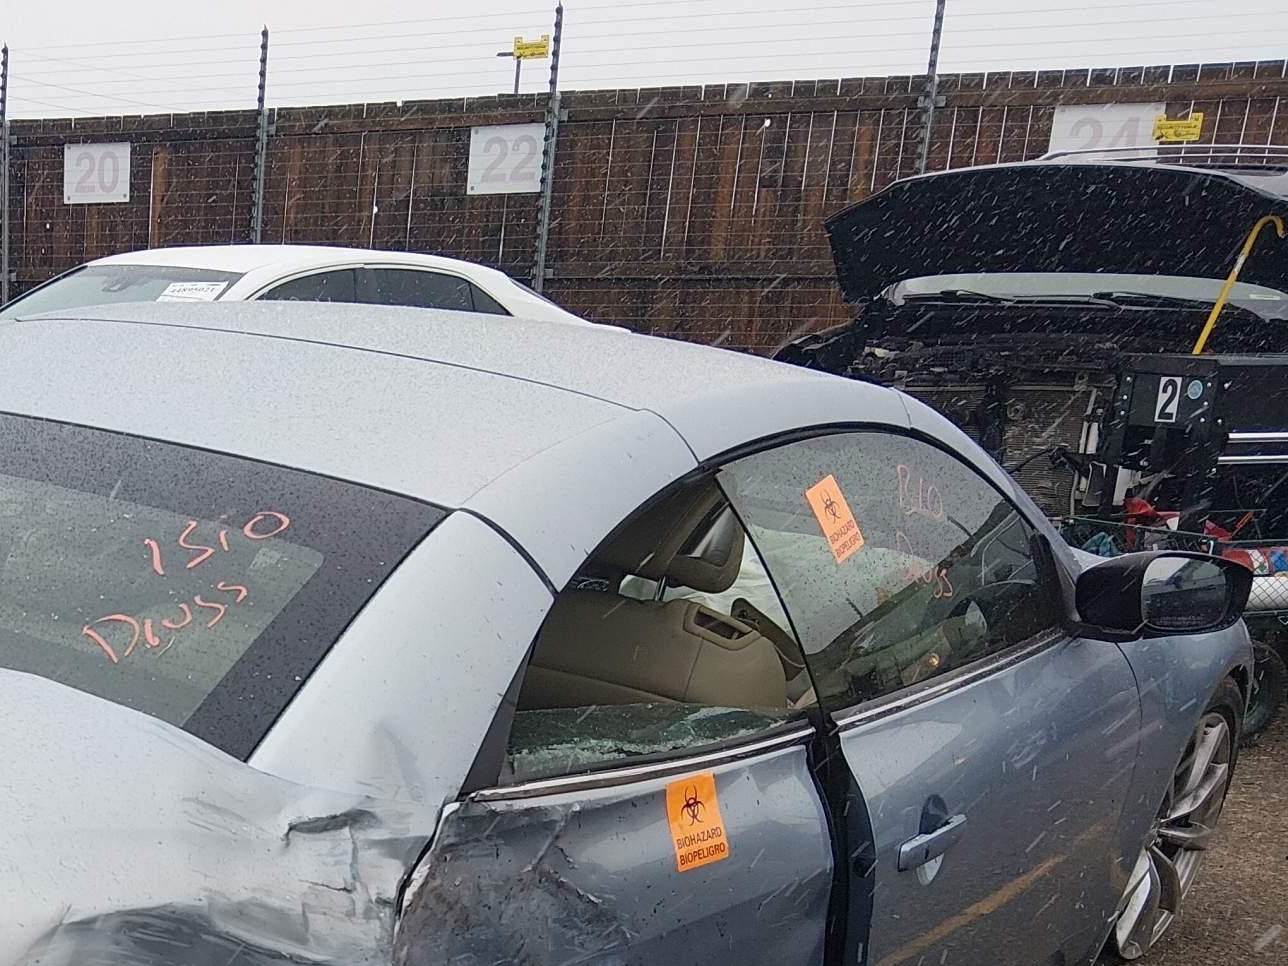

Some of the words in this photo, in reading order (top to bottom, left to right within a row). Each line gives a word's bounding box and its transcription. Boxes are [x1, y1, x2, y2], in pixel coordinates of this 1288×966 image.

[73, 151, 120, 193] 20
[480, 135, 538, 184] 22
[1157, 379, 1178, 420] 2
[676, 826, 722, 850] BIOHAZARD
[679, 842, 726, 866] BIOPELIGRO
